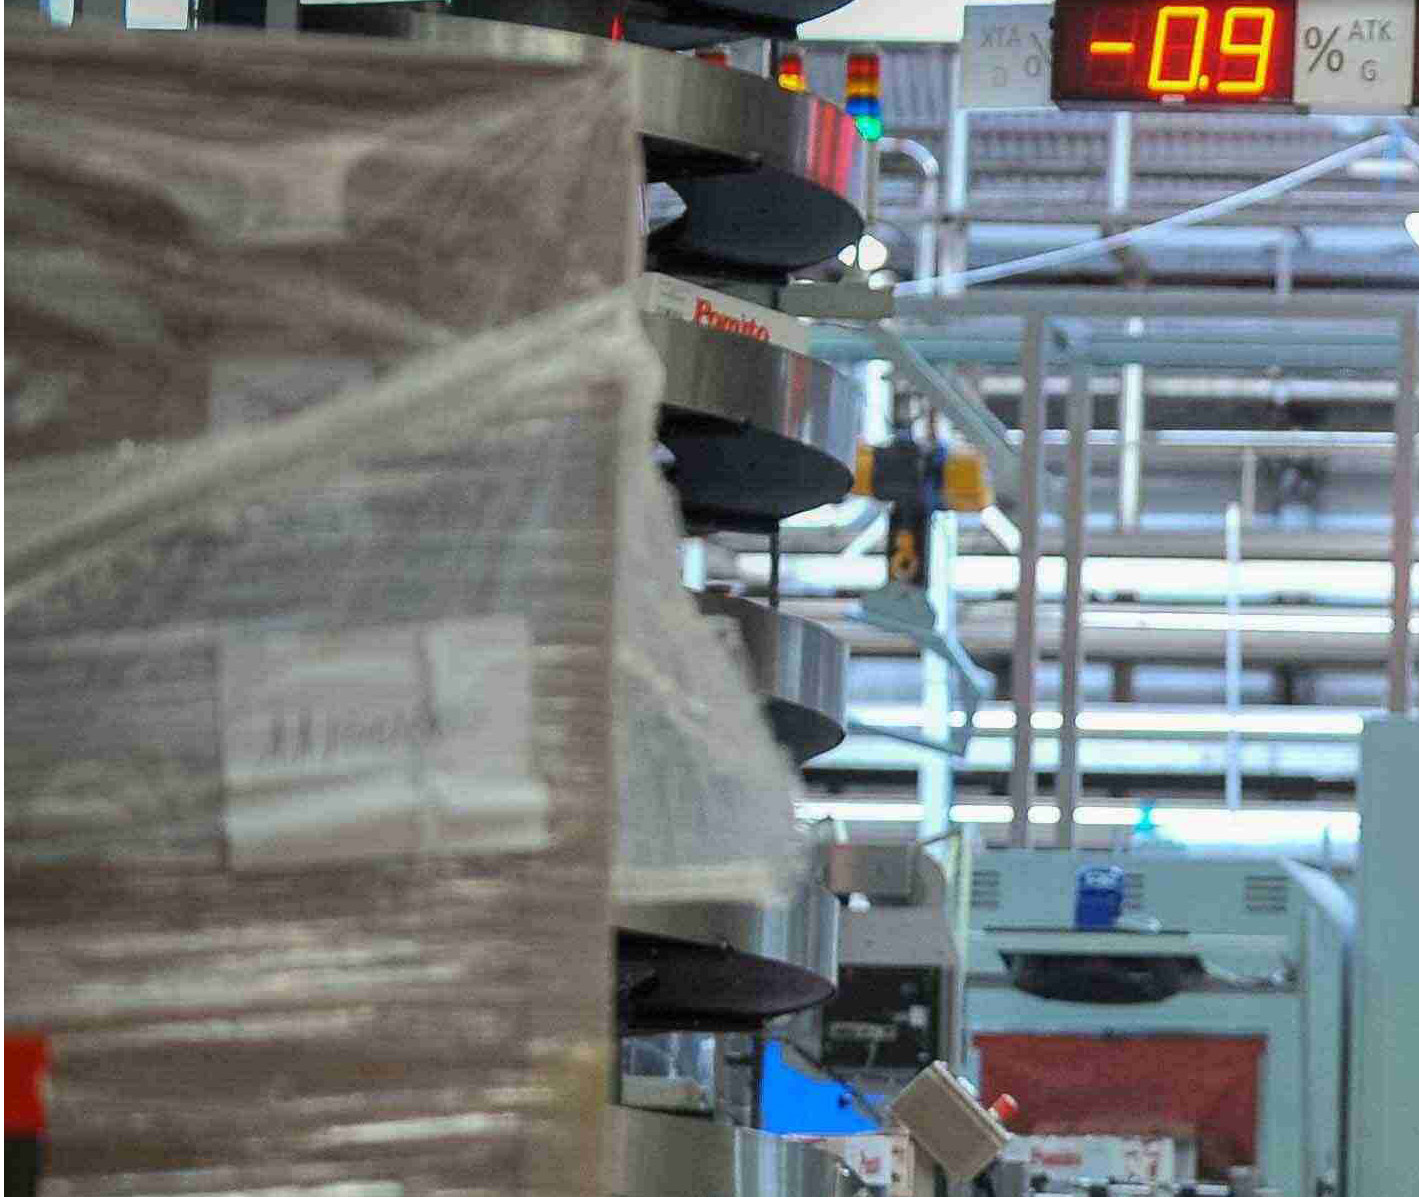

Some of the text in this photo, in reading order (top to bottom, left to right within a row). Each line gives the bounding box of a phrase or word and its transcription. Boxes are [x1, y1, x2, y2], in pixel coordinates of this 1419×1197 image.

[1089, 5, 1275, 94] -0.9
[1304, 19, 1392, 73] % ATK
[1361, 58, 1378, 82] G
